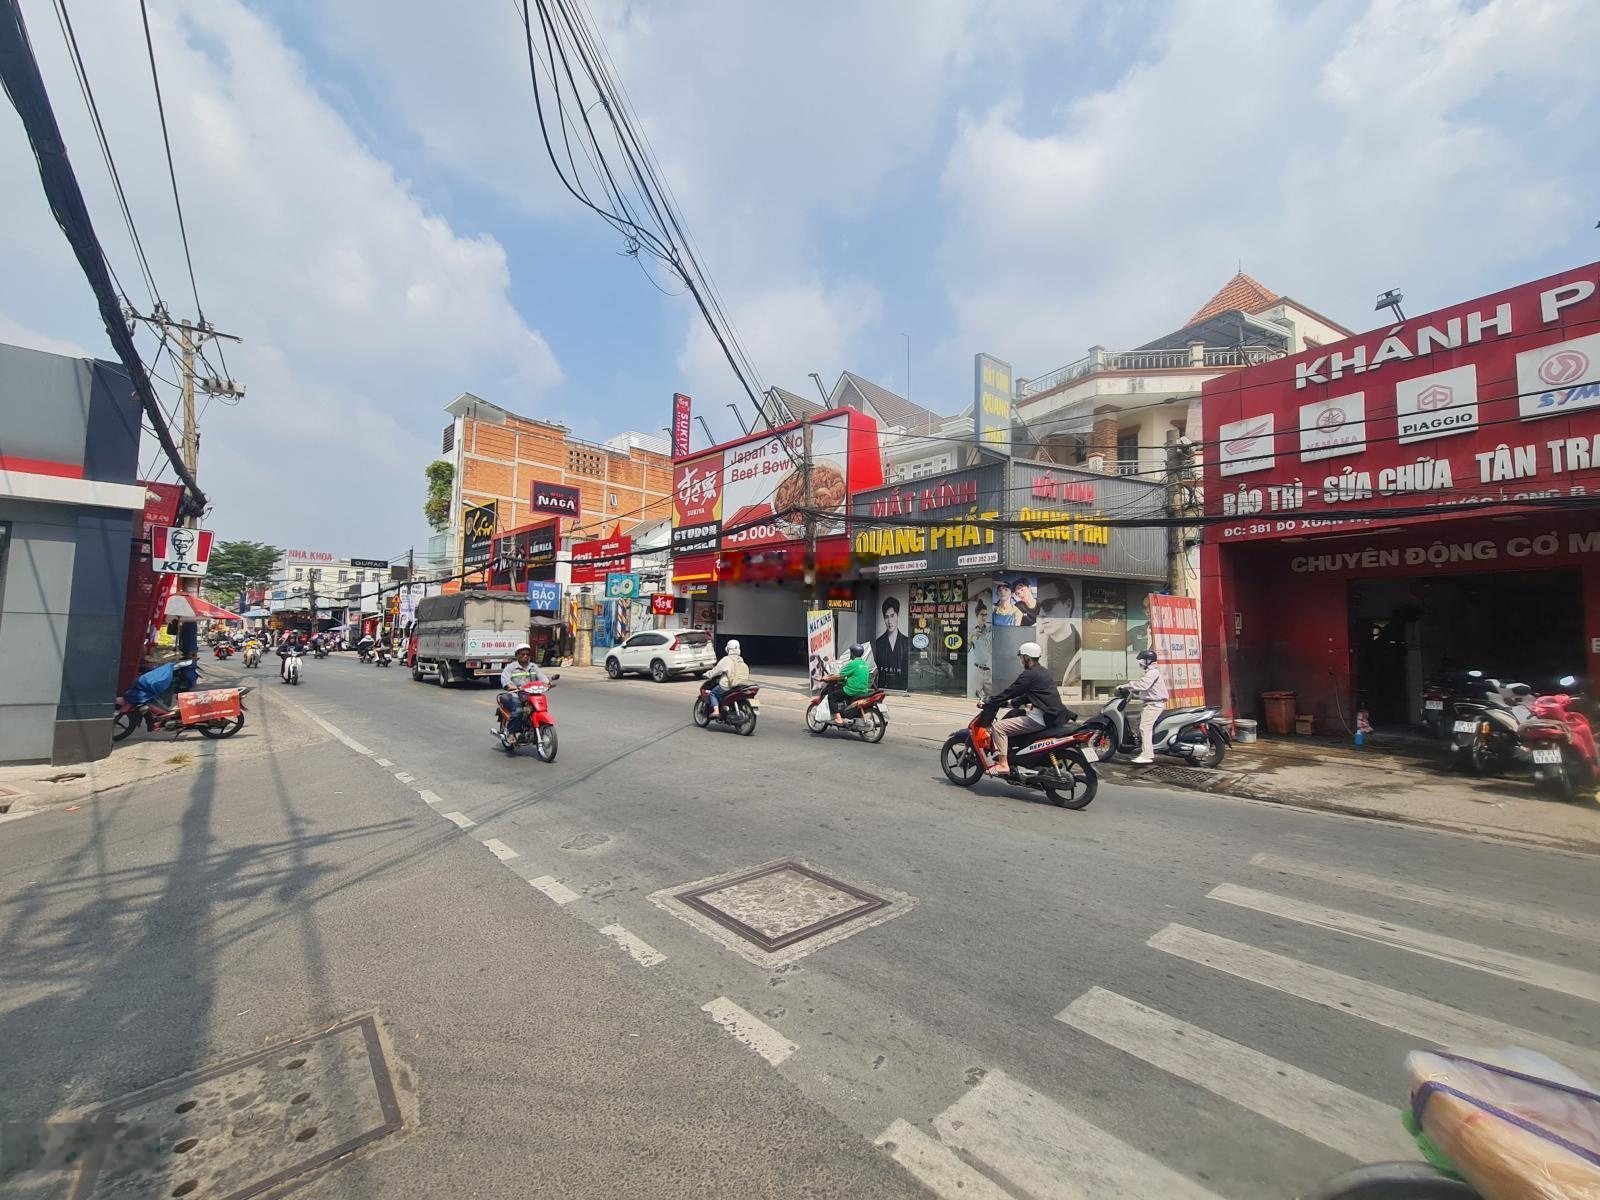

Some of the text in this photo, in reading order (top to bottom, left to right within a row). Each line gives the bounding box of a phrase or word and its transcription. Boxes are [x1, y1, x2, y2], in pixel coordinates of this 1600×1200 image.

[1295, 302, 1513, 390] KHÁNH
[1537, 383, 1600, 409] SYM
[1402, 413, 1473, 434] PIAGGIO
[731, 454, 759, 482] Beef
[1475, 443, 1537, 483] TÂN
[1223, 483, 1263, 516] BẢO
[1268, 477, 1303, 511] TRÌ
[1323, 465, 1373, 504] SỬA
[1378, 456, 1454, 496] CHỮA
[537, 495, 575, 510] NAGA
[921, 479, 977, 512] KÍNH
[687, 507, 705, 517] SUKIYA
[673, 524, 717, 541] GYUDON
[930, 505, 999, 551] PHÁT
[1224, 527, 1247, 537] ĐC:
[1249, 523, 1271, 534] 381
[310, 551, 333, 562] KHOA
[1290, 547, 1400, 573] CHUYÊN
[1404, 540, 1498, 568] ĐỘNG
[1506, 530, 1560, 557] CƠ
[160, 561, 200, 573] KFC
[532, 587, 556, 600] BẢO
[536, 599, 552, 610] VY
[947, 636, 959, 648] QP
[1029, 740, 1055, 751] REPSOL
